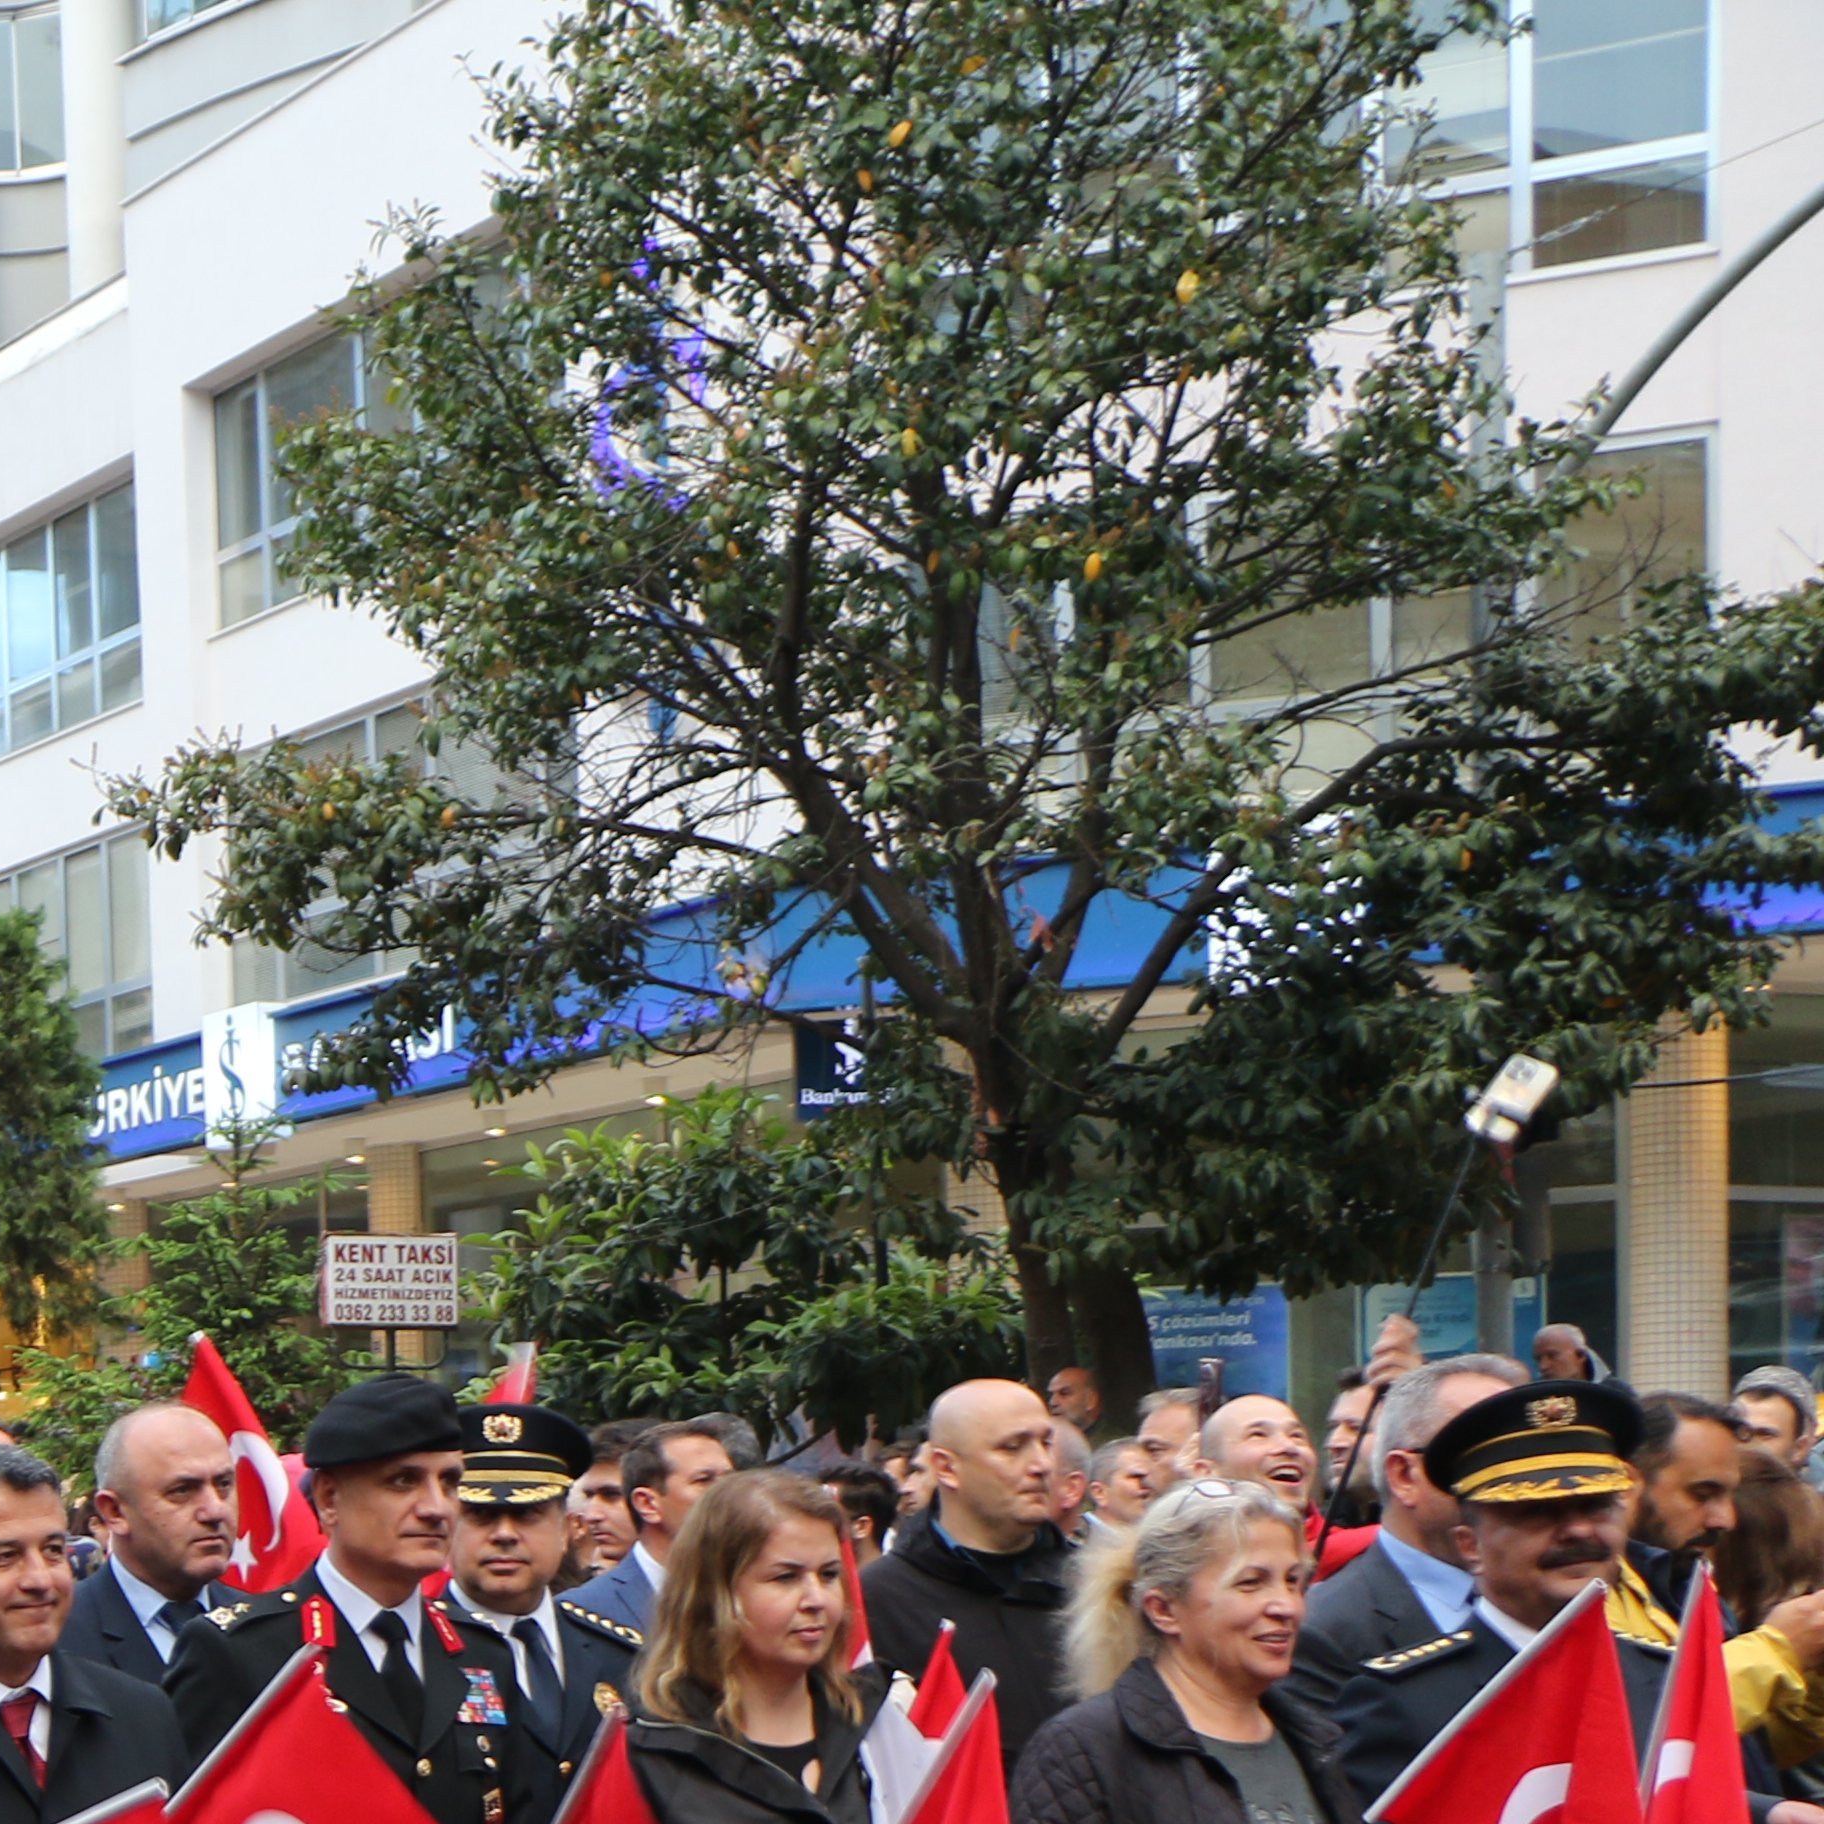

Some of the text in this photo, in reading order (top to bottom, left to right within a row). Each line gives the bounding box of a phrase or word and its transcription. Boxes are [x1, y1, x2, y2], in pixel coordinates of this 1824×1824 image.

[334, 1241, 453, 1265] KENT TAKSİ
[335, 1267, 357, 1282] 24
[363, 1268, 406, 1282] SAAT
[334, 1304, 454, 1321] 0362 233 33 88
[1161, 1311, 1251, 1333] çözümleri
[1150, 1331, 1258, 1350] ankası'nda.
